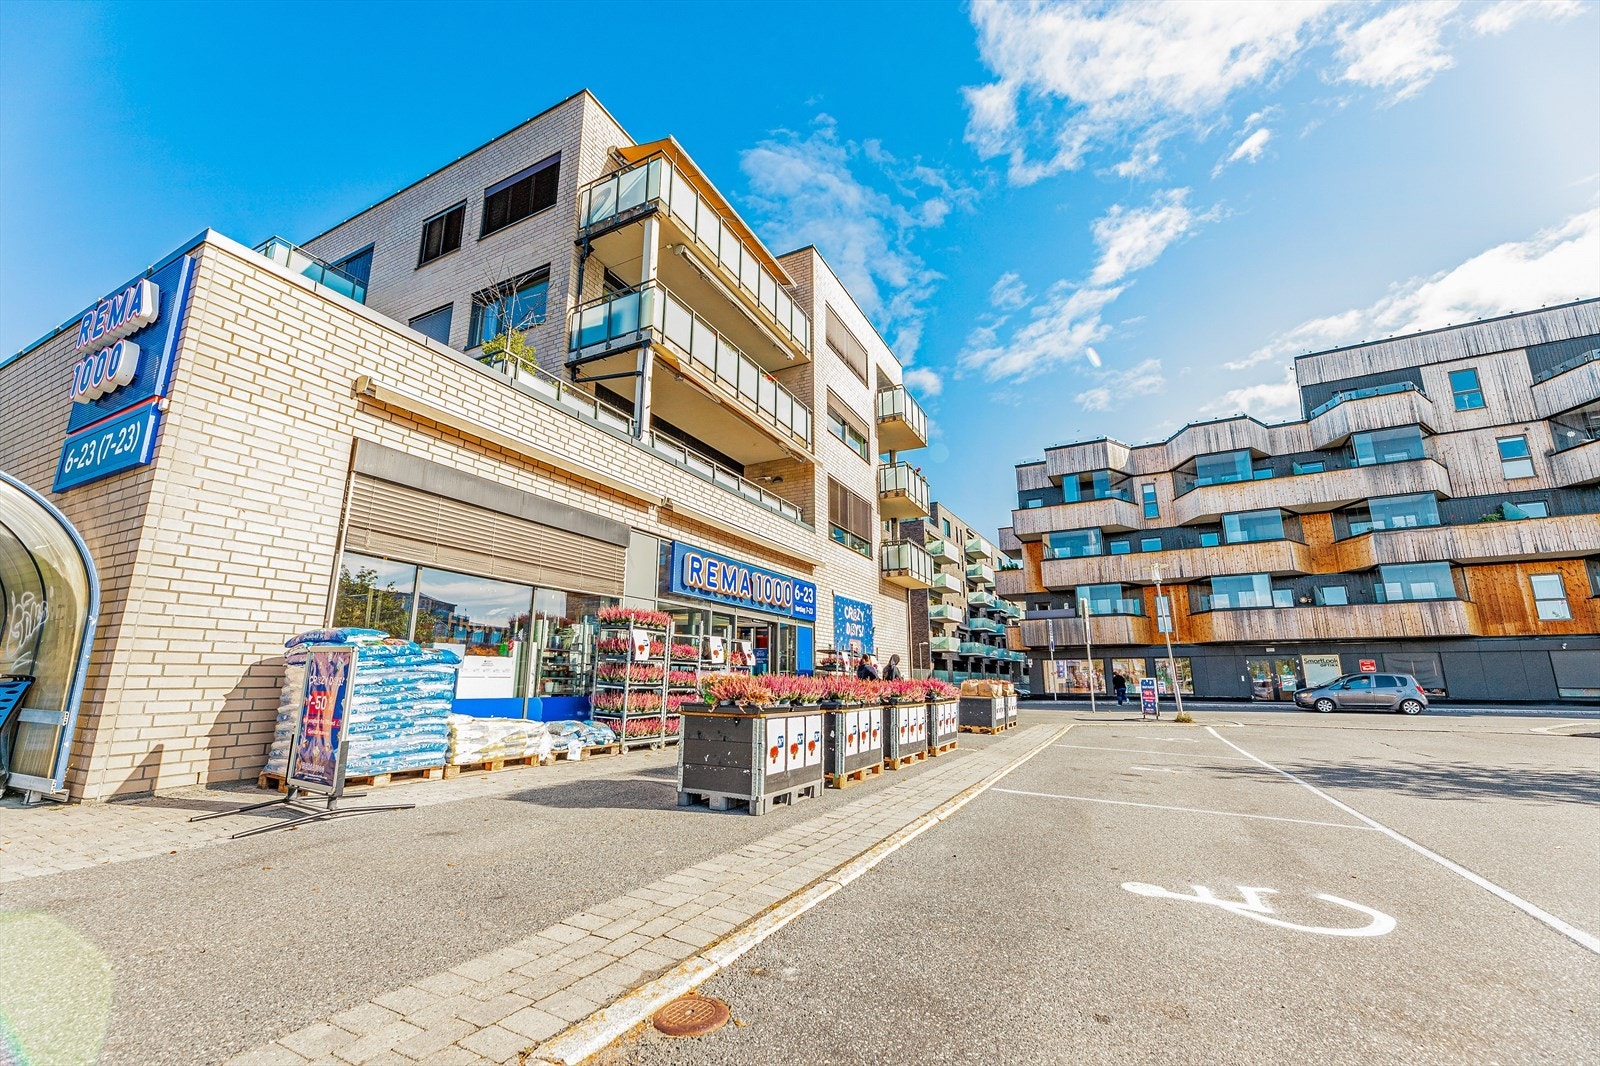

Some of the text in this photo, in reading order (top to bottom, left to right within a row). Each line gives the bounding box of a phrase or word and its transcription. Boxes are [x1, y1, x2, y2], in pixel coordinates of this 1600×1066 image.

[76, 278, 145, 350] REMA
[69, 338, 126, 401] 1000
[687, 553, 793, 607] REMA 1000
[794, 584, 814, 604] 6-23
[1303, 657, 1339, 665] SmartLook
